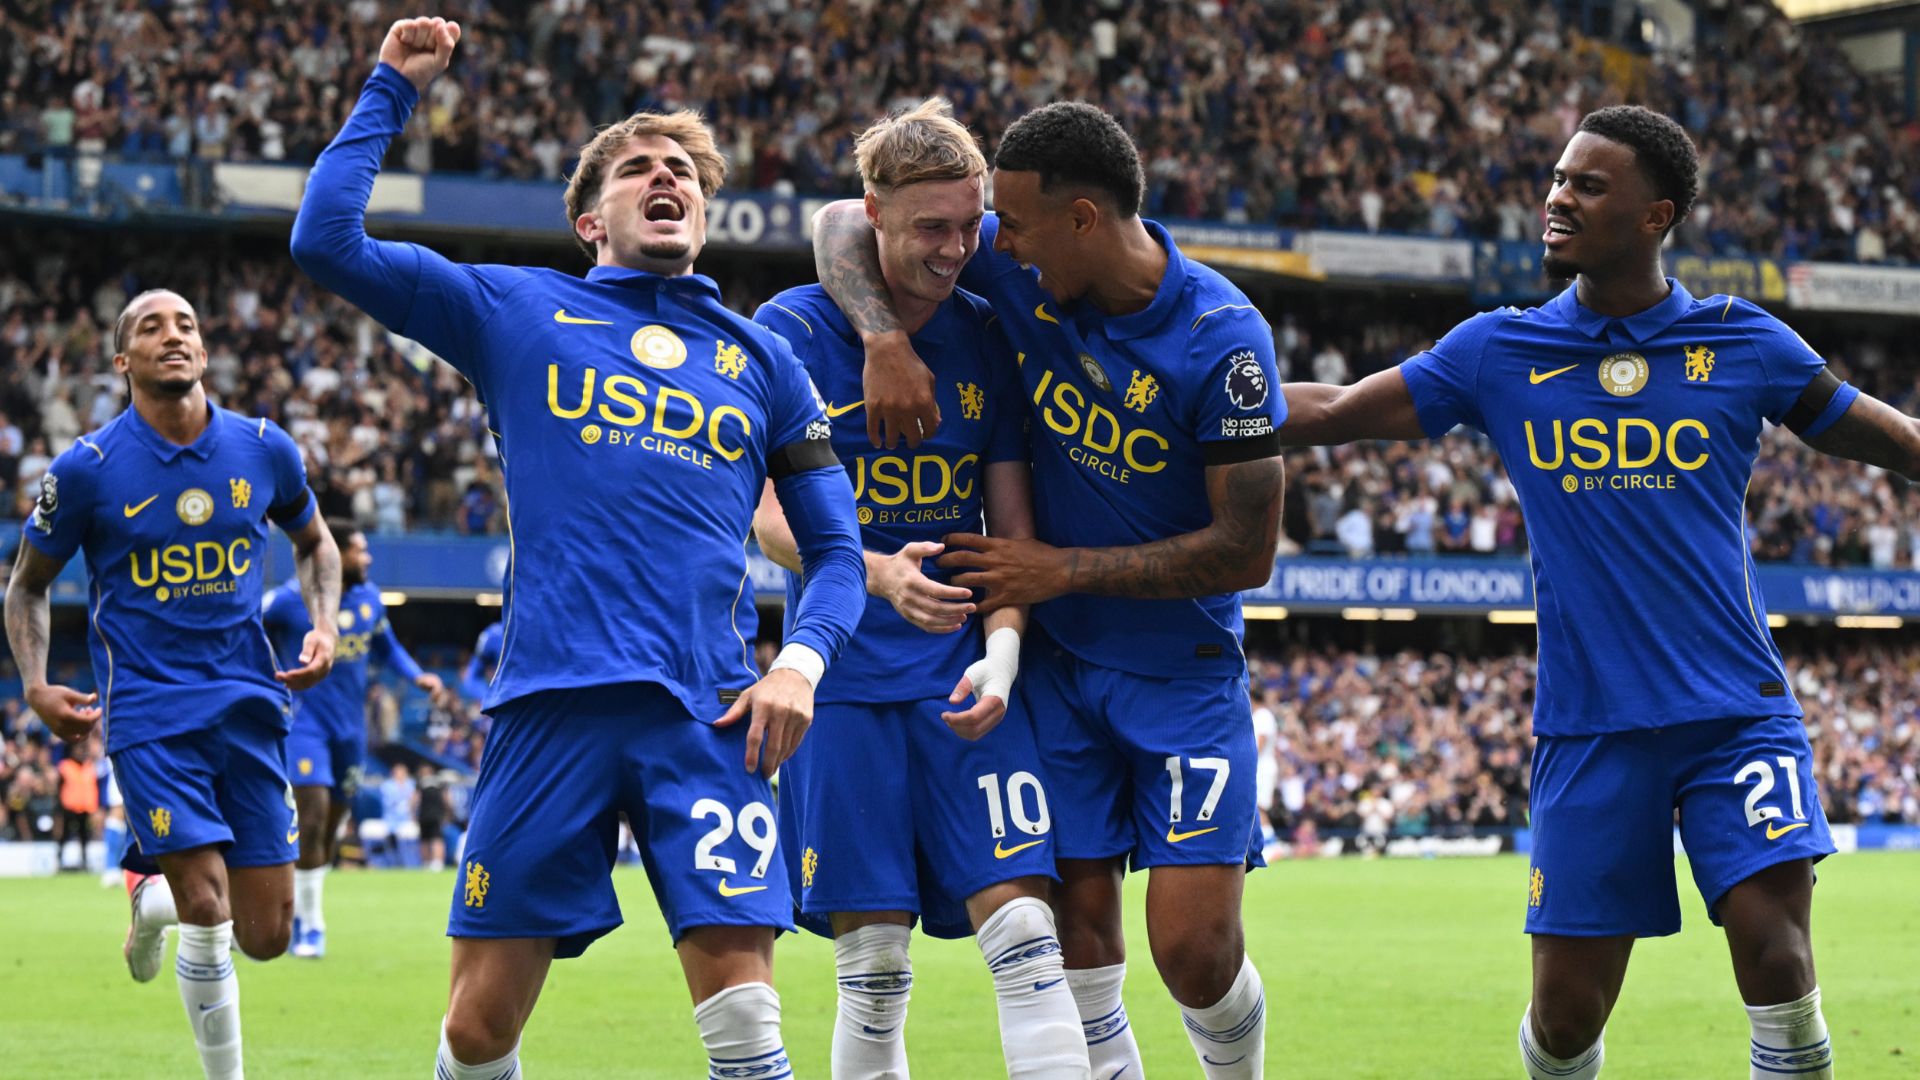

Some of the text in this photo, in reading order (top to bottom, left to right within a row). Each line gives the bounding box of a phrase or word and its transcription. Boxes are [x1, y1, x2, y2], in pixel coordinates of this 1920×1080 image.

[1614, 385, 1633, 393] FIFA
[547, 364, 751, 462] USDC
[1221, 417, 1268, 428] No room
[1239, 425, 1274, 437] racism
[608, 429, 713, 470] BY CIRCLE
[1524, 418, 1710, 471] USDC
[1068, 447, 1132, 484] CIRCLE
[1584, 475, 1676, 490] BY CIRCLE
[880, 505, 962, 523] BY CIRCLE
[129, 537, 251, 588] USDC
[173, 581, 236, 598] BY CIRCLE
[1284, 566, 1366, 599] PRIDE
[1367, 567, 1406, 600] OF
[1410, 568, 1524, 602] LONDON
[977, 771, 1051, 839] 10
[1165, 756, 1230, 823] 17
[1734, 756, 1806, 828] 21
[691, 798, 778, 879] 29
